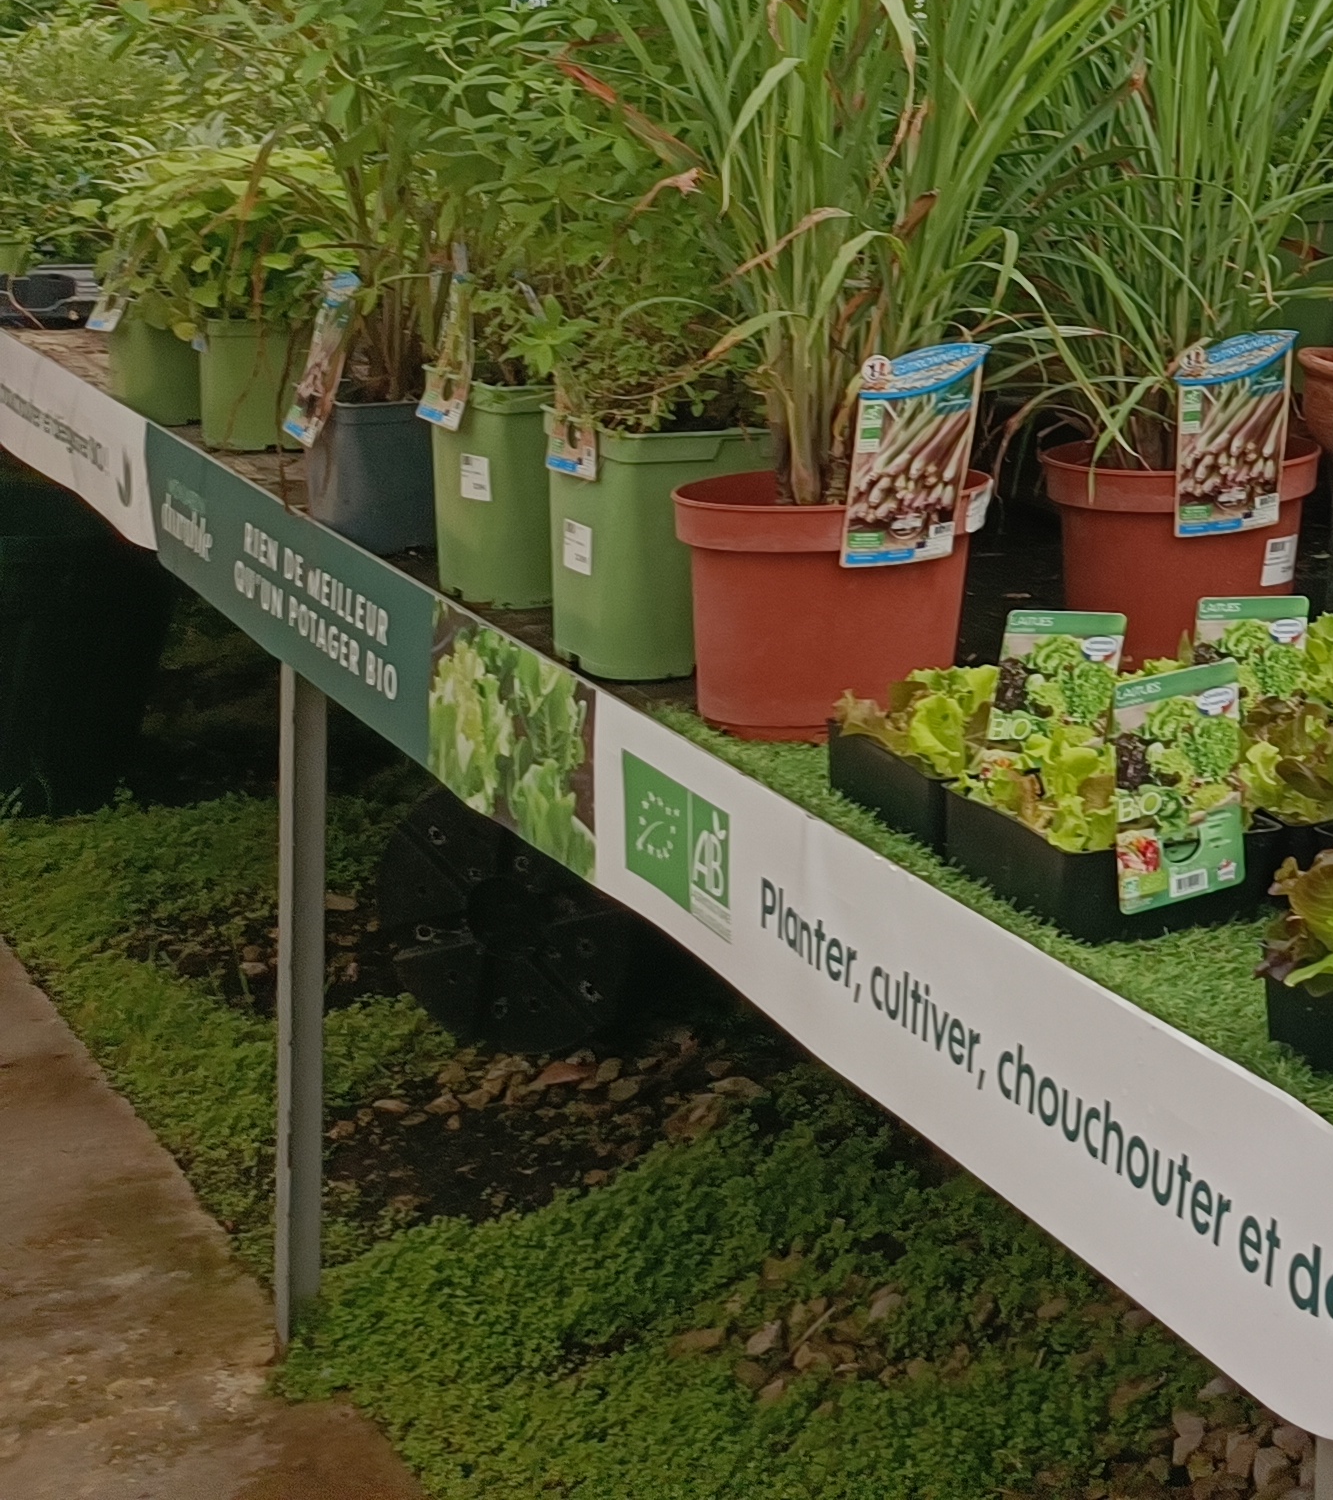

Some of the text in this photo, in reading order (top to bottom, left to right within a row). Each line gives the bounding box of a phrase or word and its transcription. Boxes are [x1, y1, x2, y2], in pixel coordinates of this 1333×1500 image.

[243, 522, 389, 646] RIEN DE MEILLEUR
[288, 595, 360, 675] POTAGER
[365, 650, 398, 700] BIO
[988, 717, 1032, 741] BIO
[1118, 791, 1163, 823] BIO
[760, 877, 861, 1003] Planter,
[870, 972, 986, 1091] cultiver,
[998, 1044, 1231, 1247] chouchouter
[1239, 1216, 1282, 1288] et
